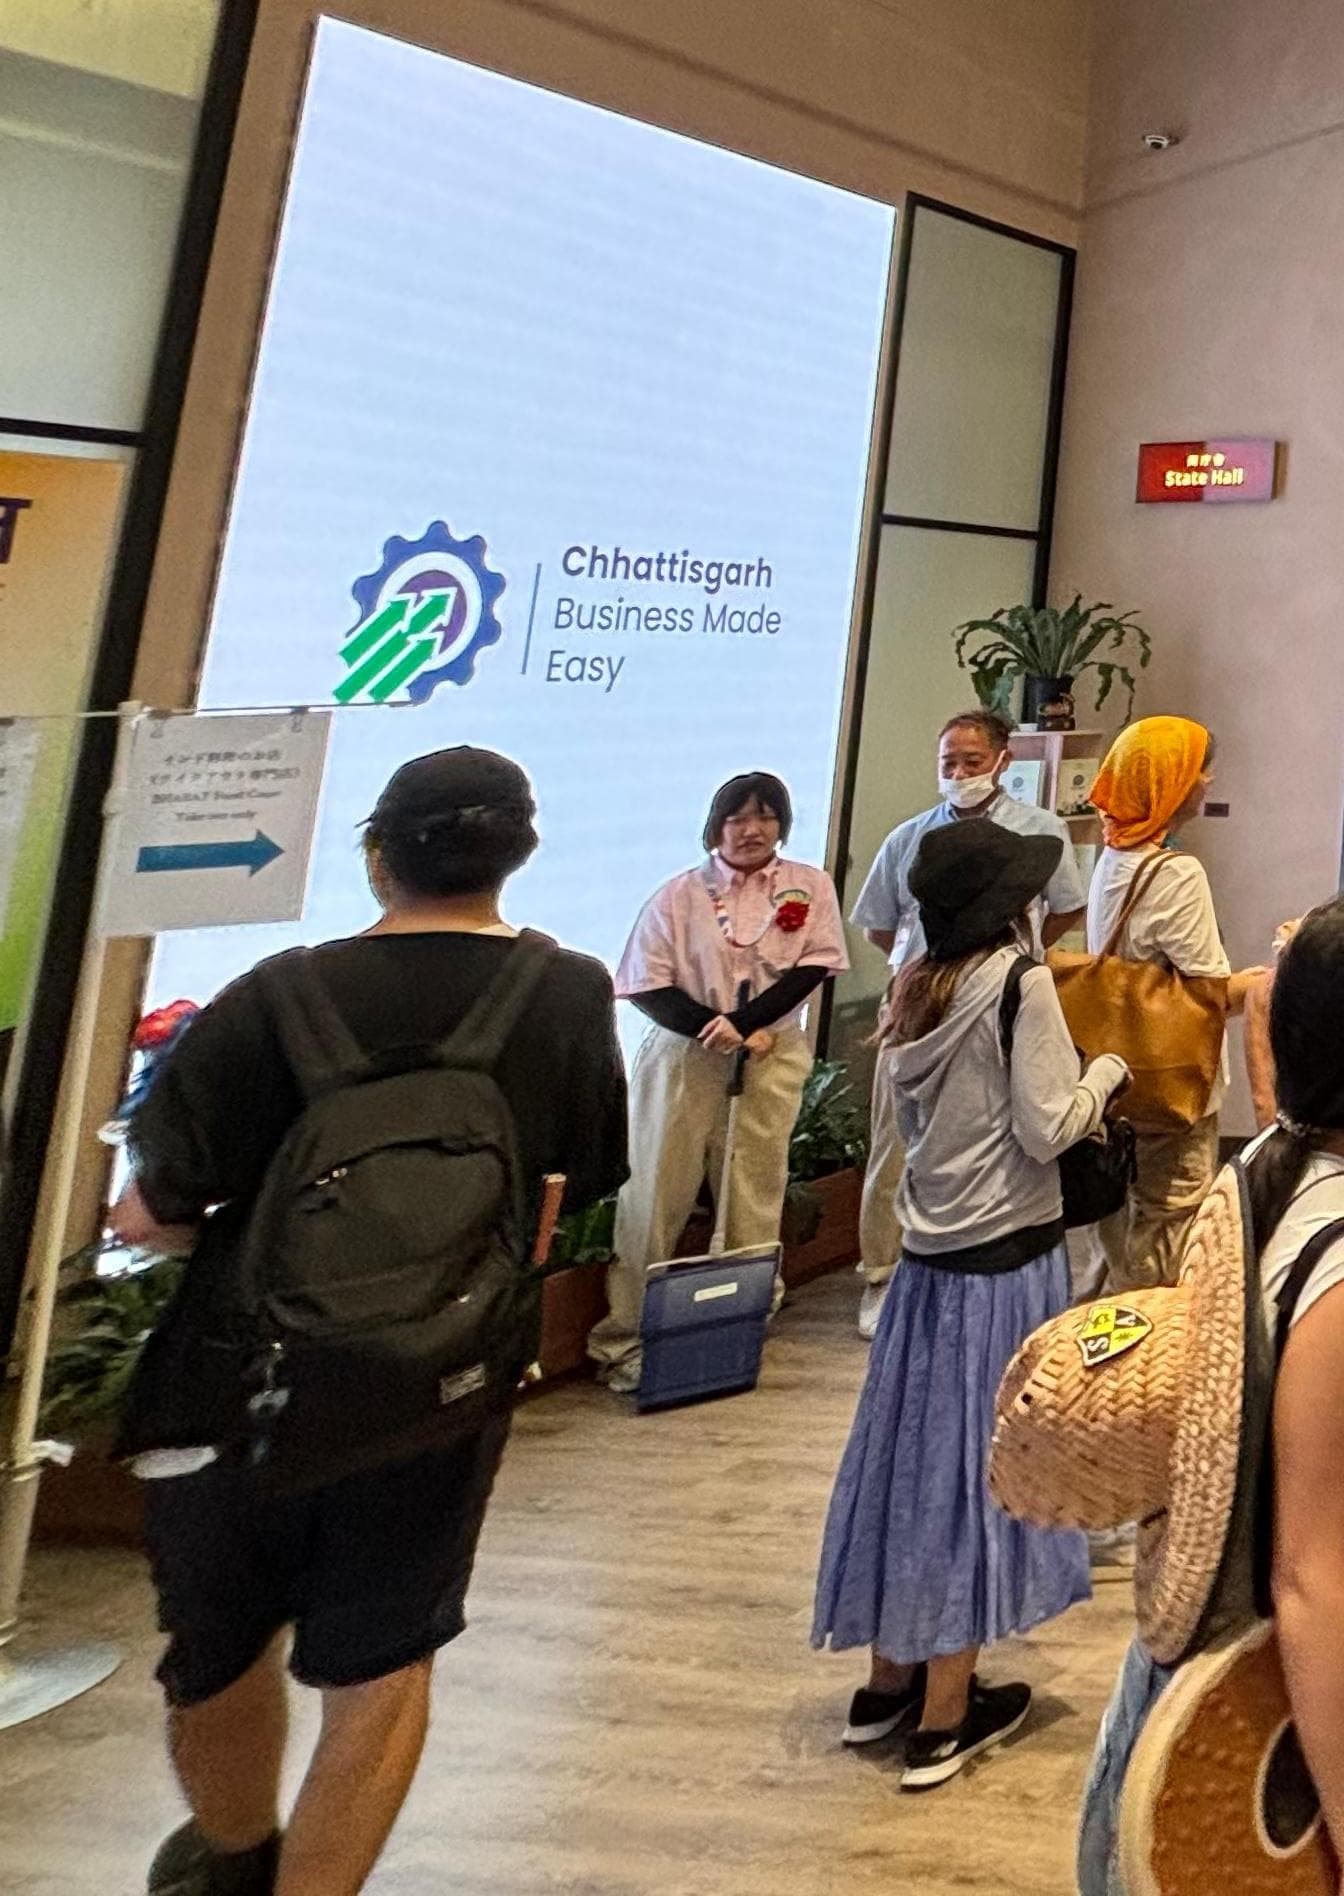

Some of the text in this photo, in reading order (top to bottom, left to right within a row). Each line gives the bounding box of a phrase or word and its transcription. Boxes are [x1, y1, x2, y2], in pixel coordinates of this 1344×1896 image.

[1165, 467, 1244, 486] State Hall
[562, 545, 773, 594] Chhattisgarh
[554, 596, 781, 634] Business Made
[546, 650, 626, 693] Easy
